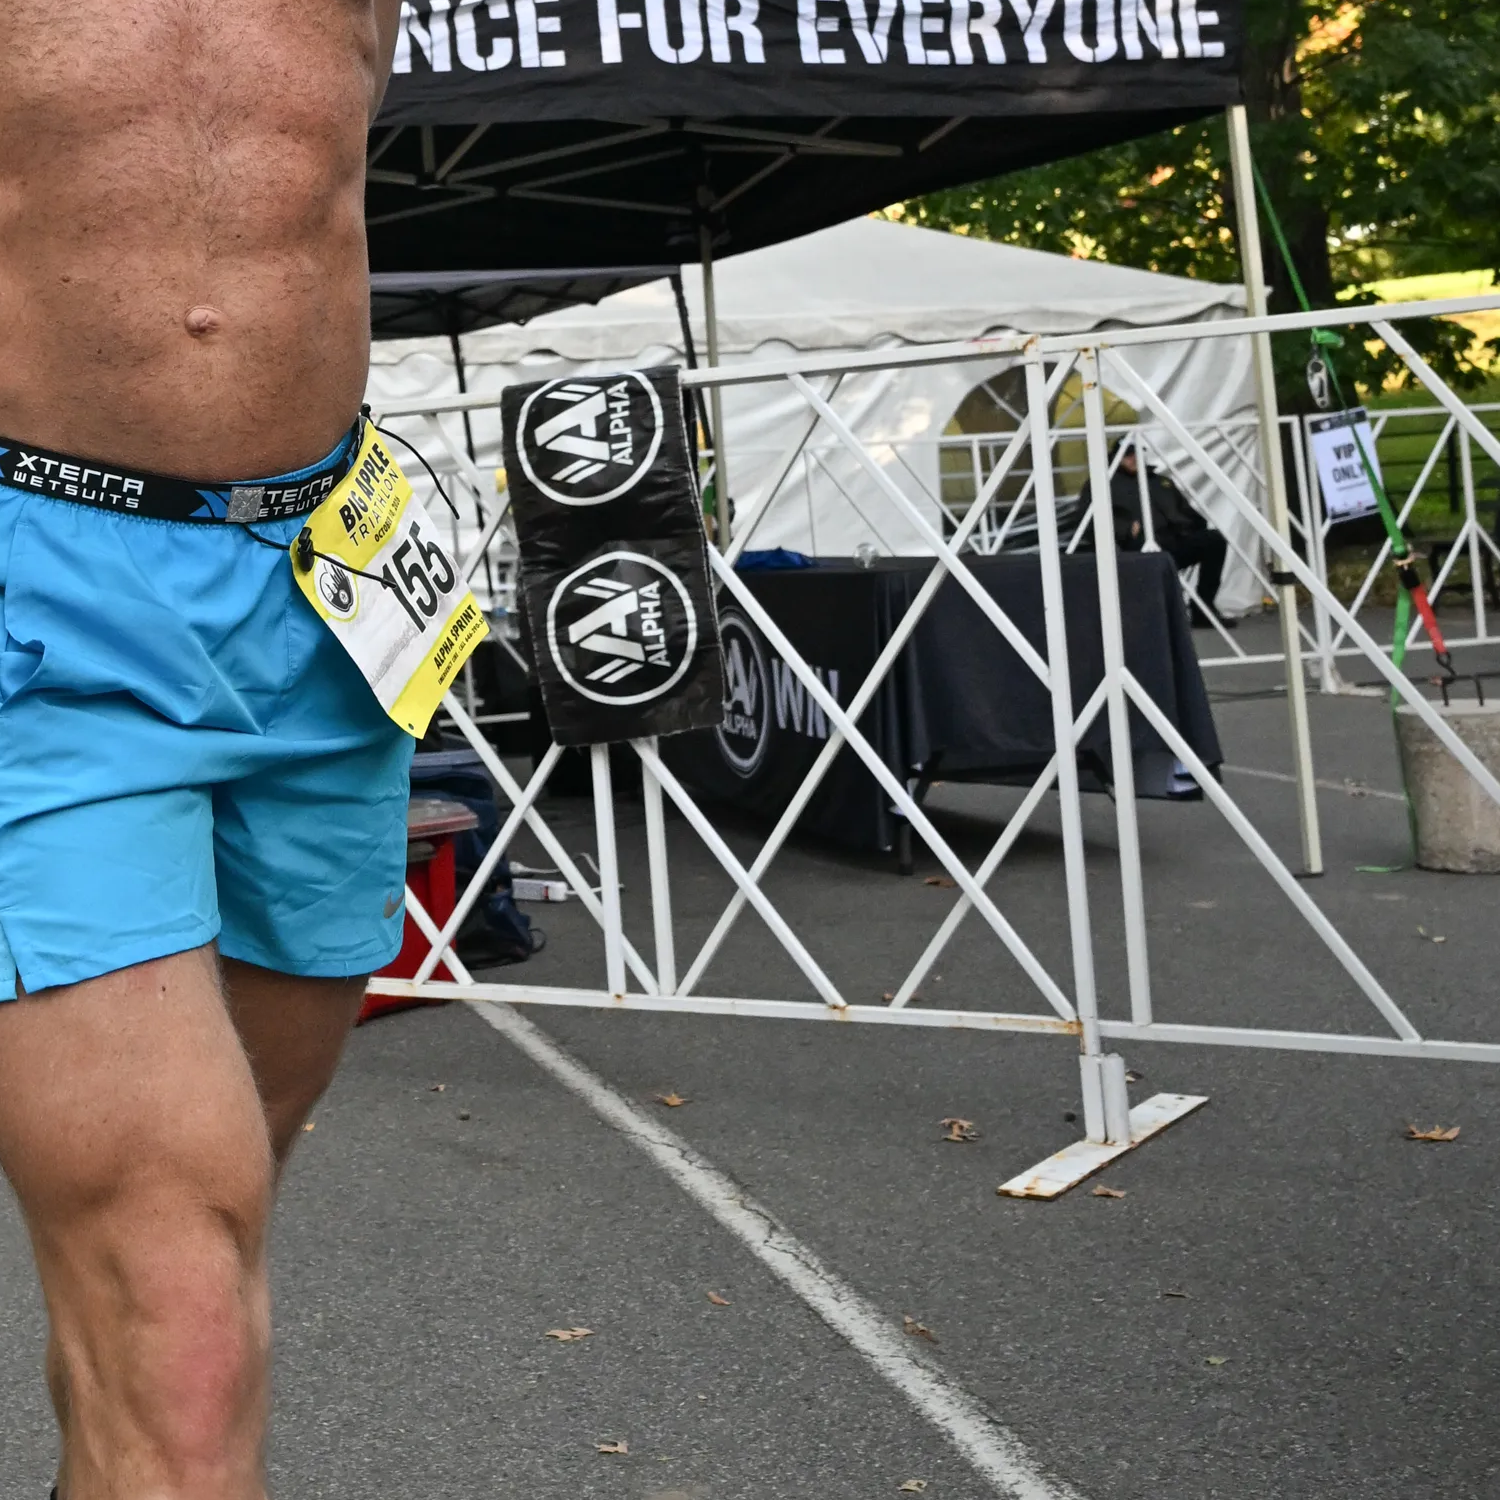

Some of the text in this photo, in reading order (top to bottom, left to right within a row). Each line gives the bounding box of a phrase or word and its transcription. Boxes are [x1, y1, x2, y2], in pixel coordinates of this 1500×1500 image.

[606, 380, 634, 466] ALPHA
[1333, 443, 1355, 460] VIP
[12, 470, 140, 509] WETSUITS
[16, 451, 145, 496] XTERRA
[258, 491, 329, 518] ETSUITS
[339, 443, 390, 533] BIG APPLE
[349, 468, 399, 547] TRIATHLON
[380, 520, 457, 634] 155
[433, 604, 477, 671] ALPHA SPRINT
[637, 579, 672, 668] ALPHA
